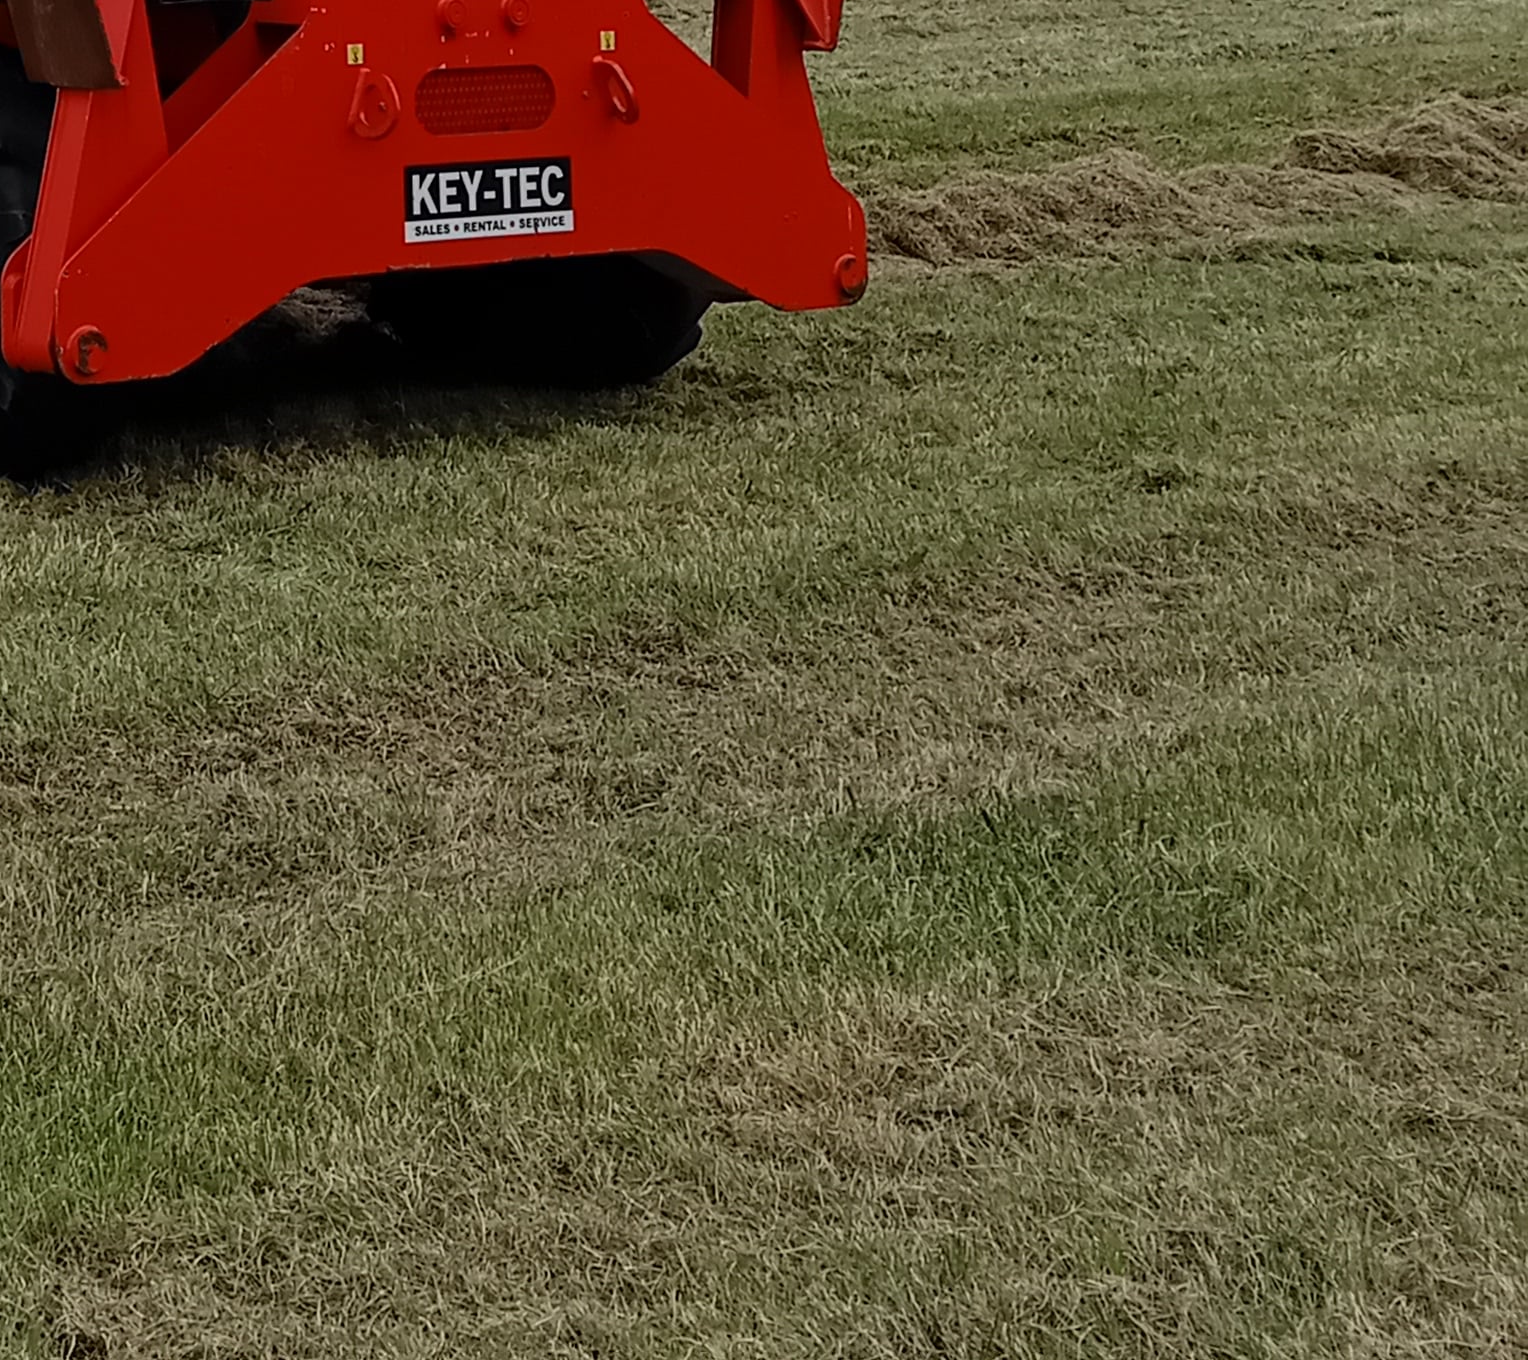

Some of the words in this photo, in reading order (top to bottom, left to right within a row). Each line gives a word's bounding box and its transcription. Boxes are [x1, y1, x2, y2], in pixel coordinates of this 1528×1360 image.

[411, 165, 566, 216] KEY-TEC
[414, 224, 451, 237] SALES
[463, 220, 507, 233] RENTAL
[519, 215, 566, 229] SERVICE
